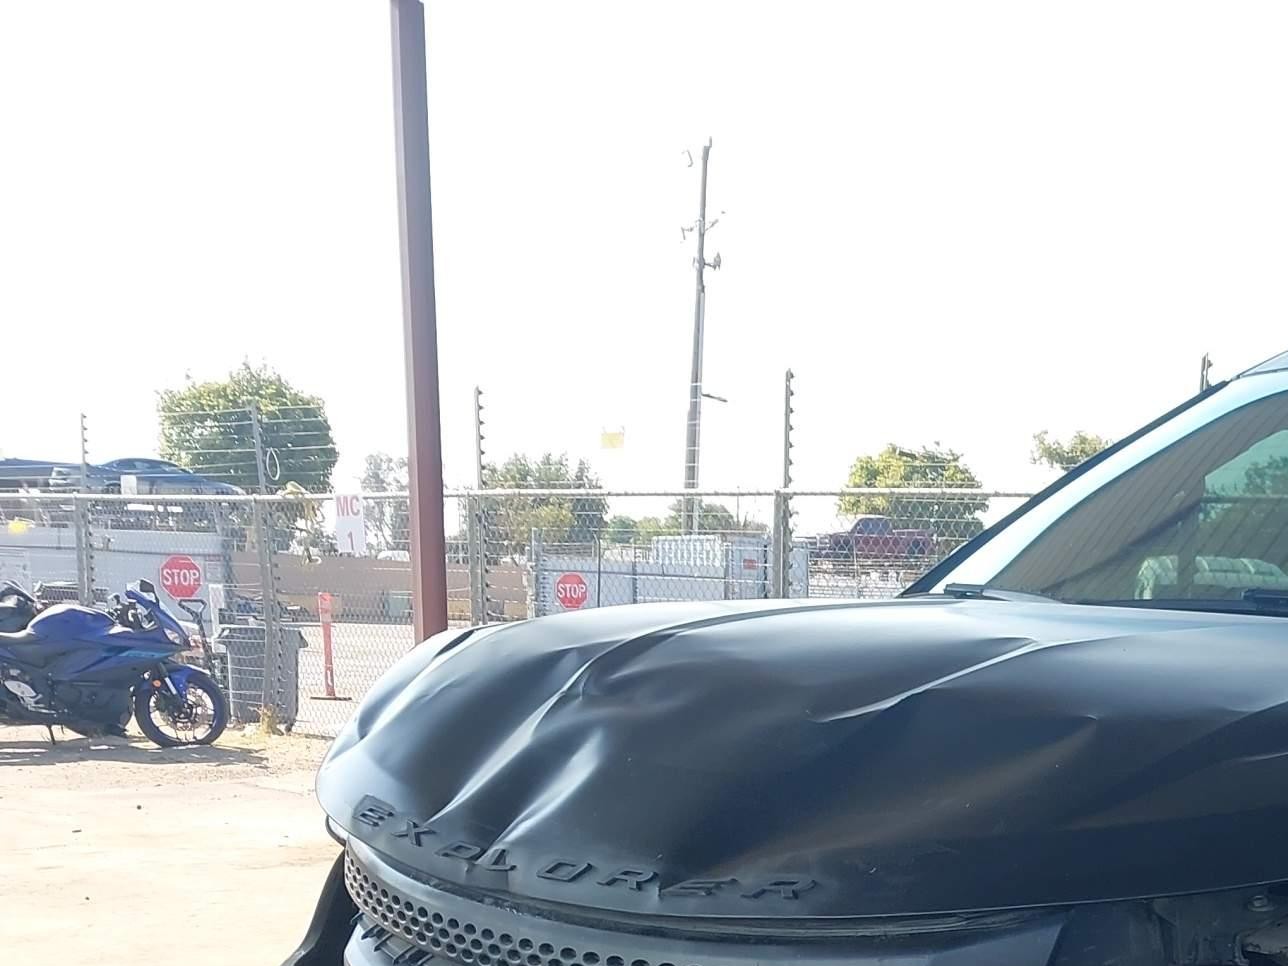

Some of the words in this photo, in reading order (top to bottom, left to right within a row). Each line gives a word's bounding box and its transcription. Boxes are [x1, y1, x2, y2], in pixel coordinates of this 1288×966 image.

[336, 495, 361, 517] MC
[347, 531, 354, 550] 1
[162, 569, 200, 587] STOP
[557, 583, 586, 599] STOP
[352, 793, 818, 901] EXPLORER
